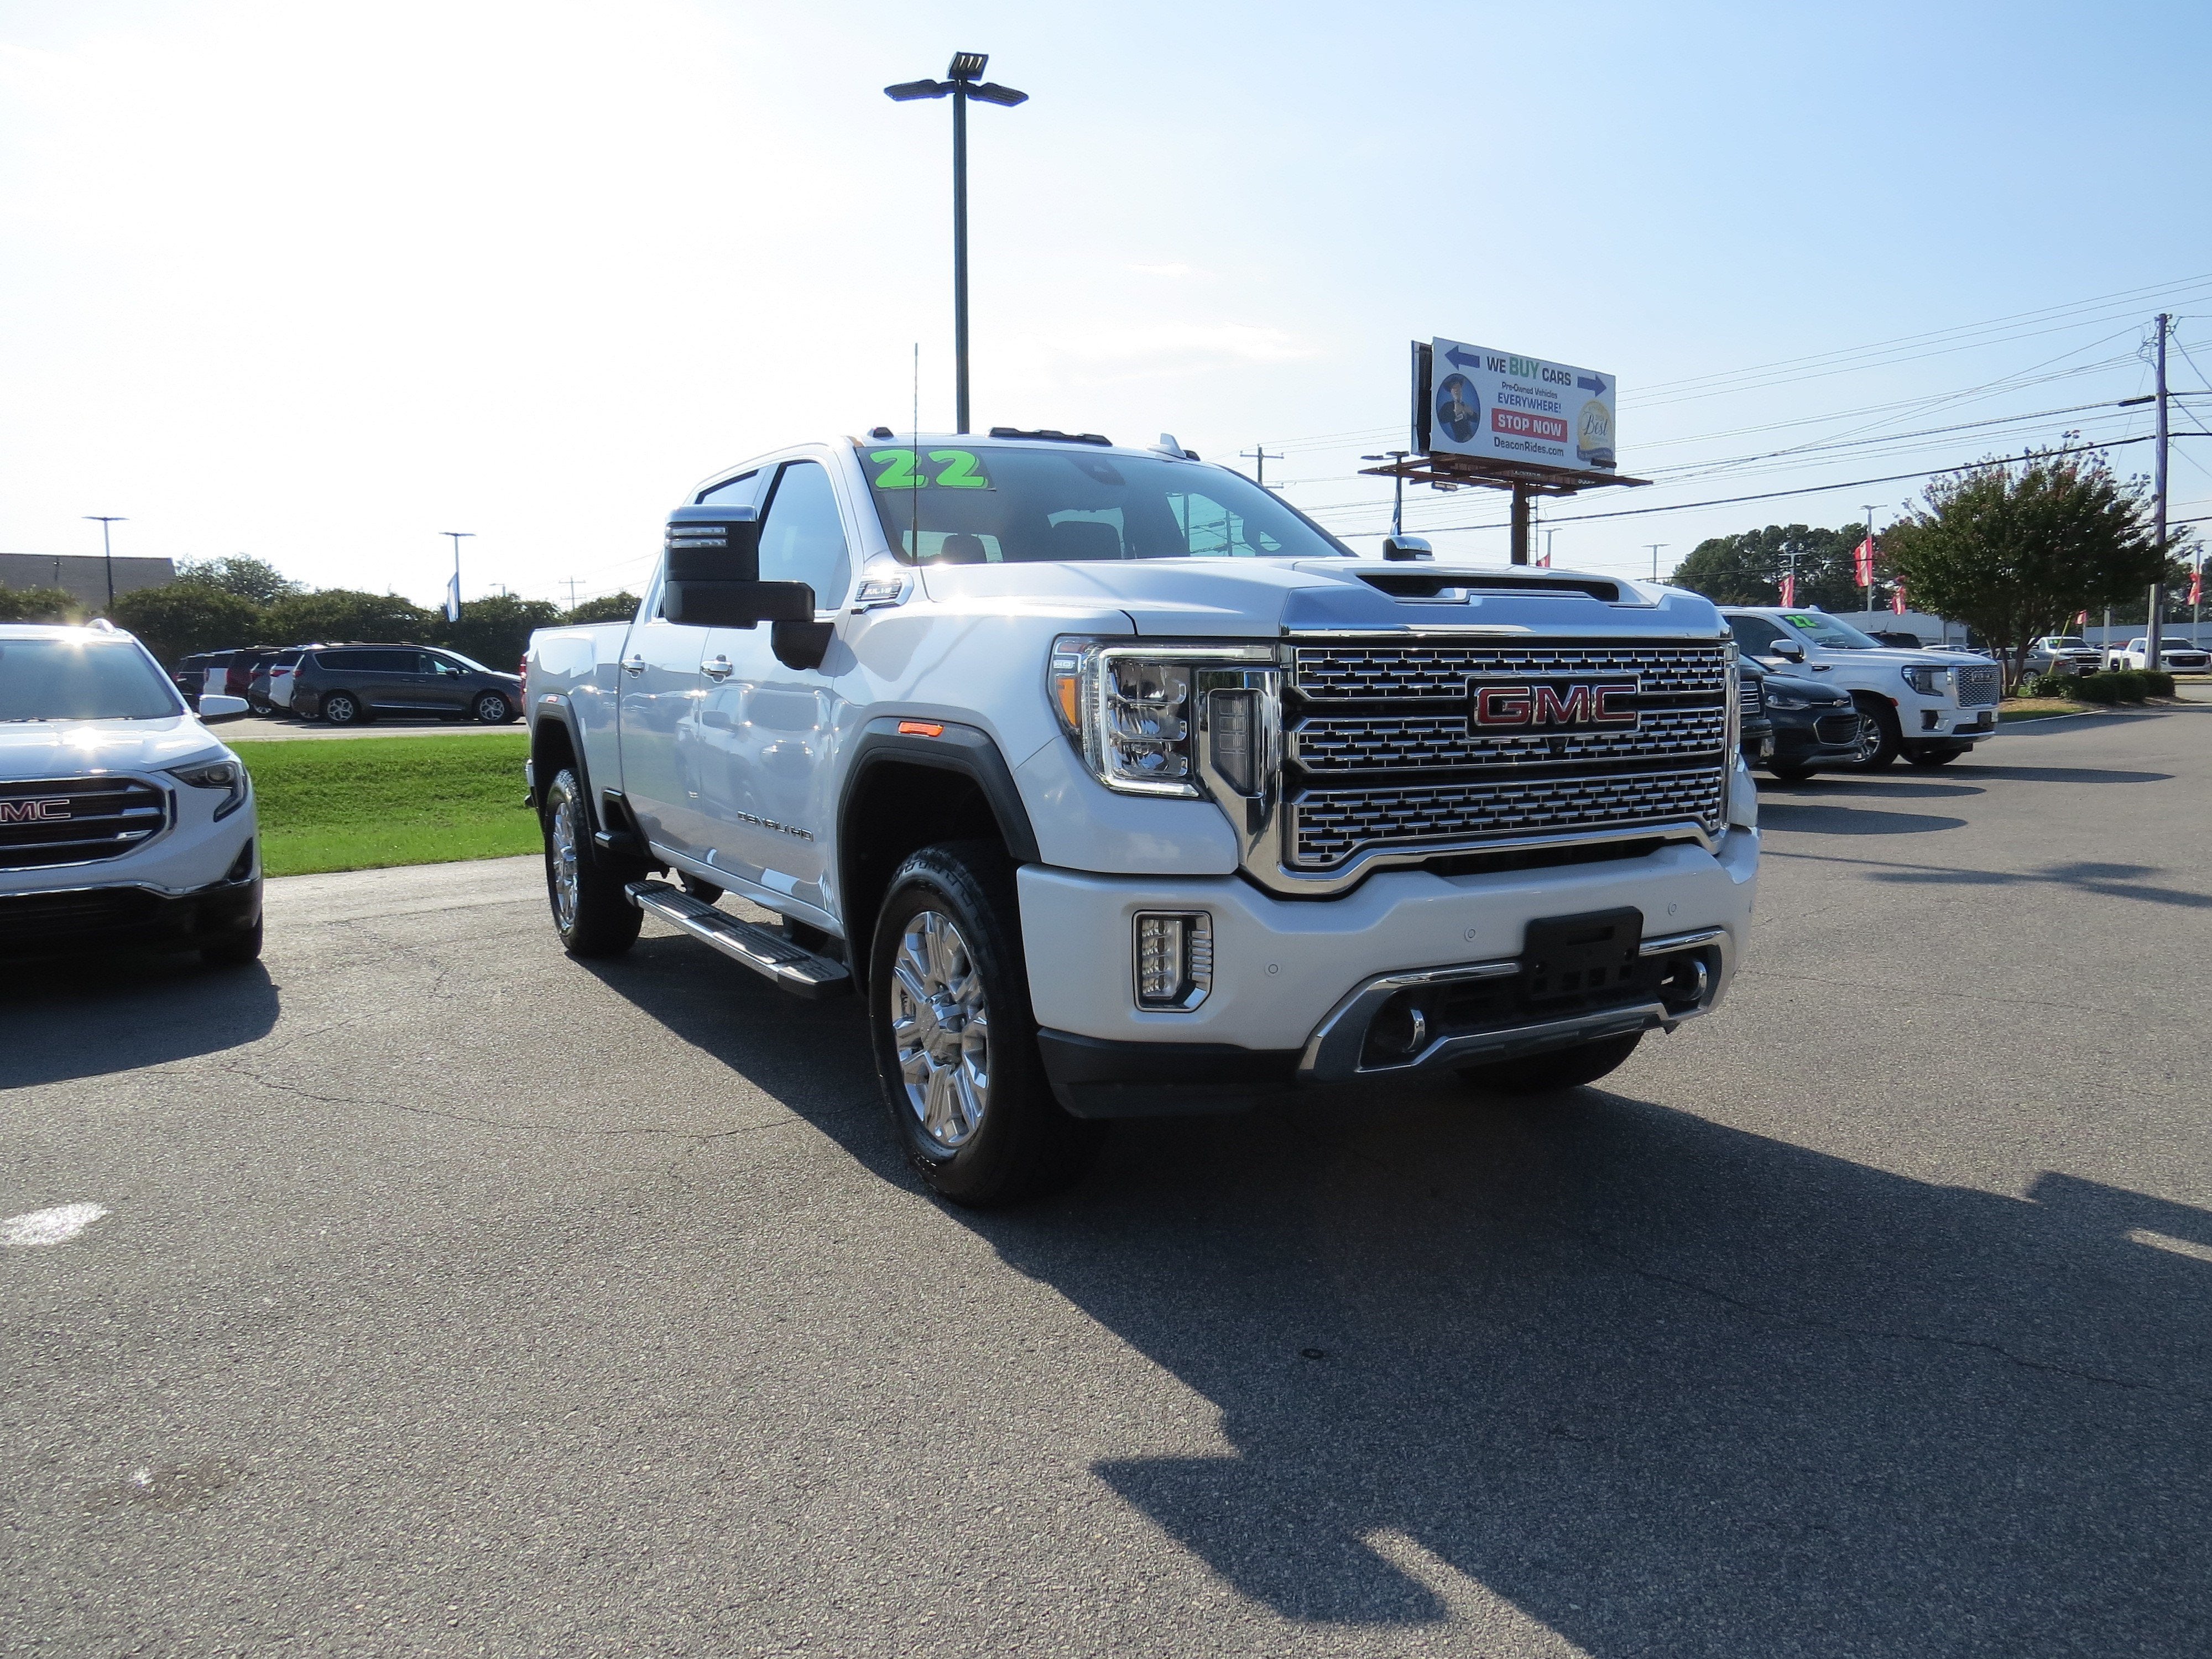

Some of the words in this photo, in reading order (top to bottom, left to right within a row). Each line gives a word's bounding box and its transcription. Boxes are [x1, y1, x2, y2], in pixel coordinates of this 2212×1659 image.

[1487, 356, 1506, 373] WE
[1510, 356, 1540, 379] BUY
[1542, 368, 1571, 386] CARS
[1502, 382, 1533, 395] Pre-Owned
[1534, 387, 1558, 399] Vehicles
[1498, 392, 1561, 414] EVERYWHERE!
[1498, 414, 1530, 431] STOP
[1533, 420, 1561, 436] NOW
[1582, 412, 1608, 436] Best
[1494, 436, 1564, 456] DeaconRides.com
[870, 449, 988, 489] 22
[1785, 615, 1818, 628] 22
[1474, 684, 1637, 726] GMC
[0, 799, 71, 822] MC
[737, 810, 789, 834] DENALI
[790, 826, 814, 842] HD
